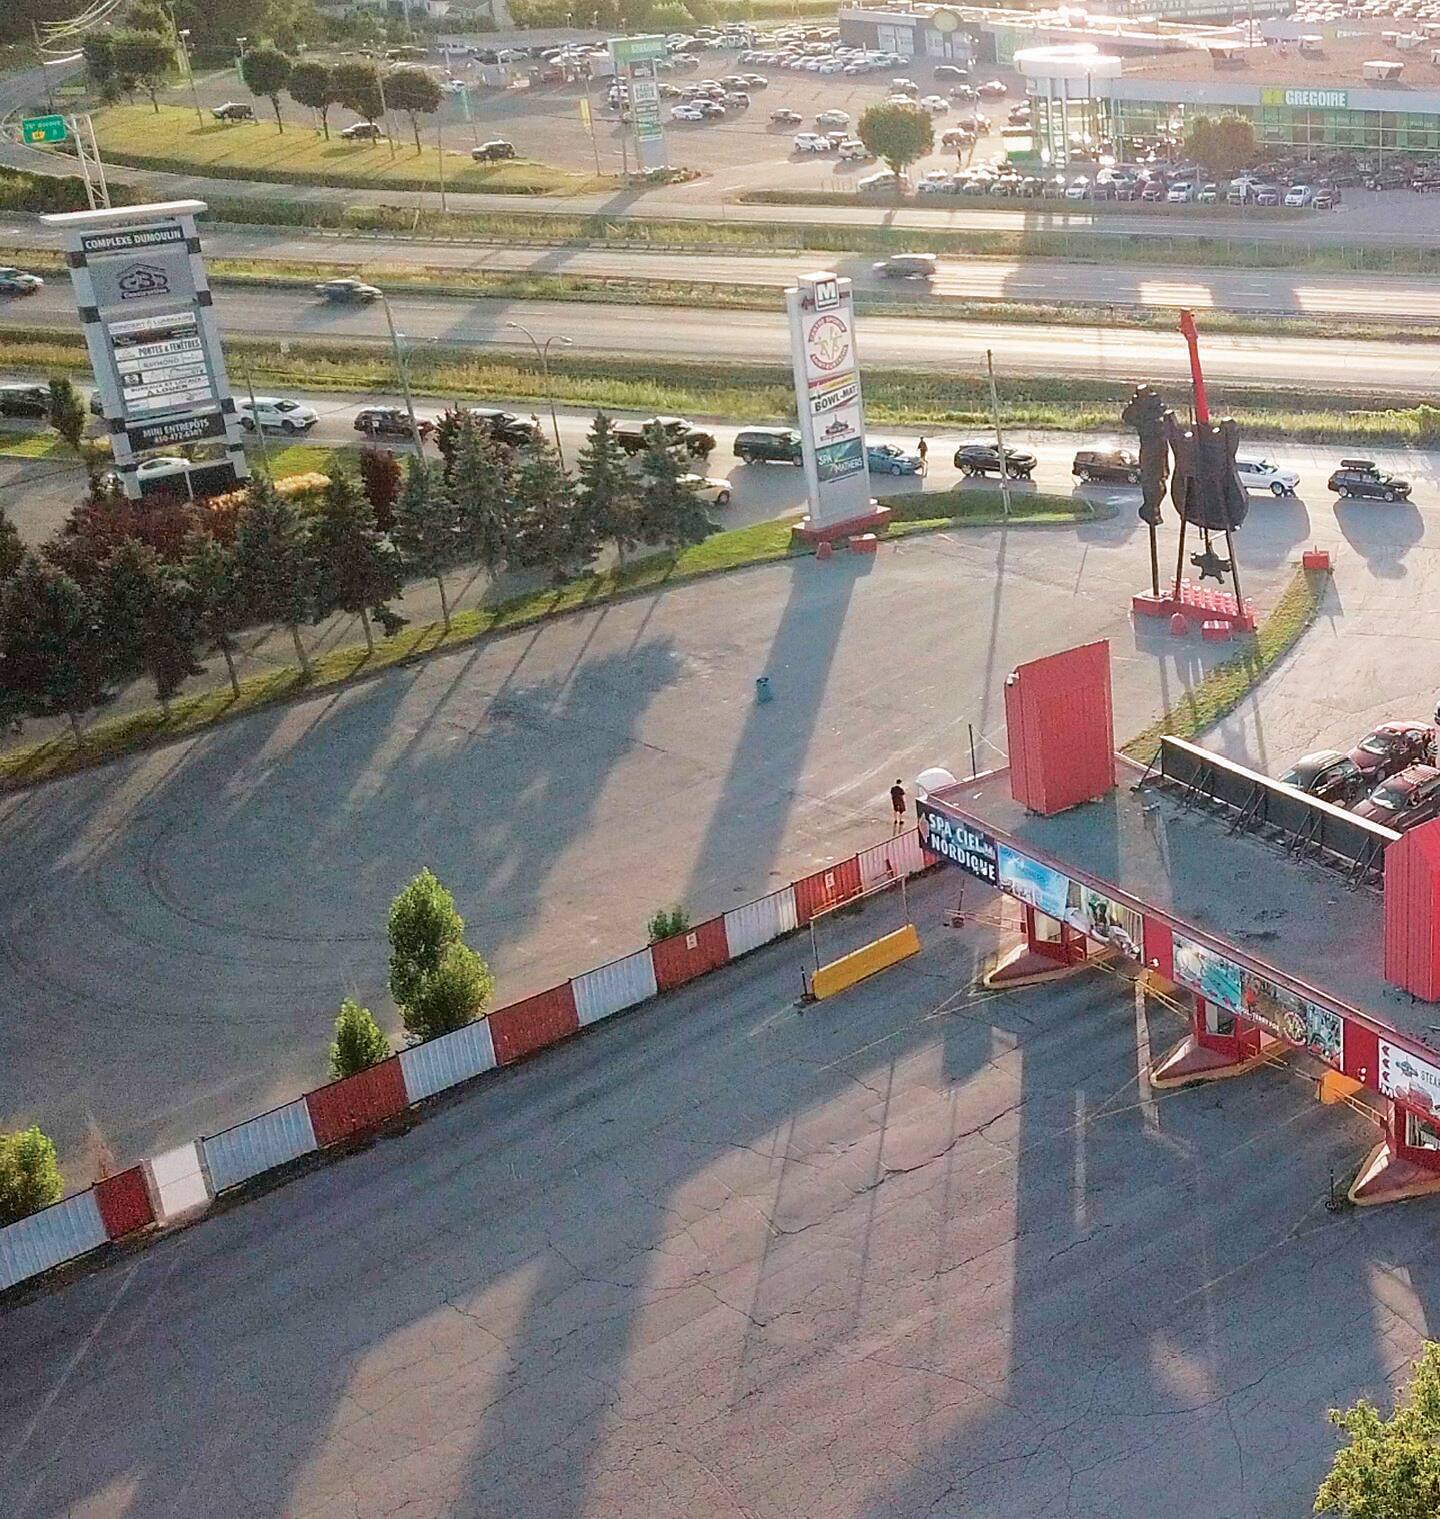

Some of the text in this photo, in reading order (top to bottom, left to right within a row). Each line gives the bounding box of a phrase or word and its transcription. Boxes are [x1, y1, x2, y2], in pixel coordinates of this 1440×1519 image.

[1285, 89, 1346, 107] GREGOIRE
[85, 230, 181, 249] COMPLEXE DUMOULIN
[815, 385, 857, 412] BOWL-MAT
[142, 427, 163, 438] MINI
[928, 813, 952, 840] SPA
[931, 832, 997, 880] NORDIQUE
